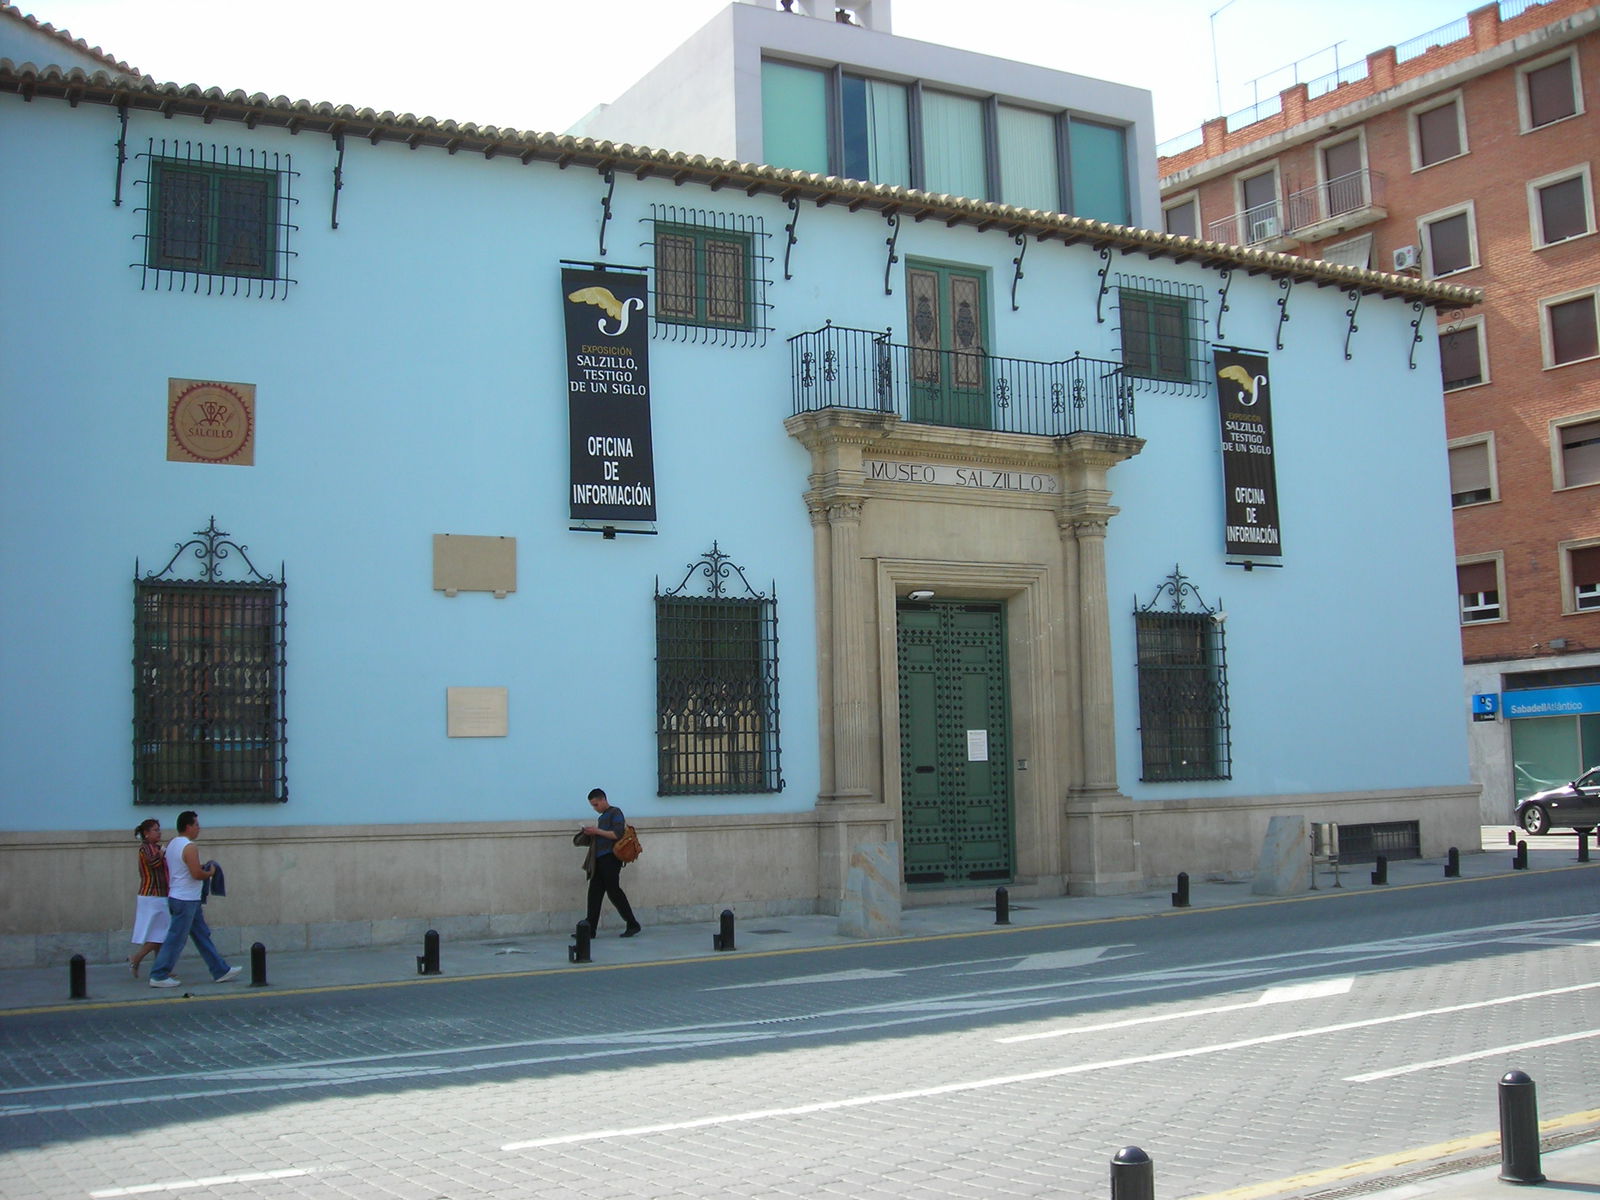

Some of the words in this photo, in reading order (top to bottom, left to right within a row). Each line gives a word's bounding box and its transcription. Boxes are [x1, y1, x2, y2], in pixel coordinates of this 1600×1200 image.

[582, 345, 632, 355] EXPOSICIÓN
[577, 355, 637, 370] SALZILLO,
[584, 370, 632, 382] TESTIGO
[570, 381, 586, 392] DE
[591, 383, 607, 393] UN
[612, 384, 646, 395] SIGLO
[188, 427, 233, 439] SALCILLO
[1226, 421, 1265, 434] SALZILLO,
[1232, 433, 1262, 443] TESTIGO
[587, 436, 634, 458] OFICINA
[1223, 442, 1233, 451] DE
[1236, 444, 1247, 452] UN
[1249, 445, 1271, 455] SIGLO
[603, 461, 620, 481] DE
[871, 461, 936, 483] MUSEO
[955, 469, 1043, 492] SALZILLO
[573, 482, 652, 506] INFORMACIÓN
[1235, 487, 1266, 505] OFICINA
[1246, 507, 1258, 524] DE
[1227, 524, 1279, 544] INFORMACIÓN
